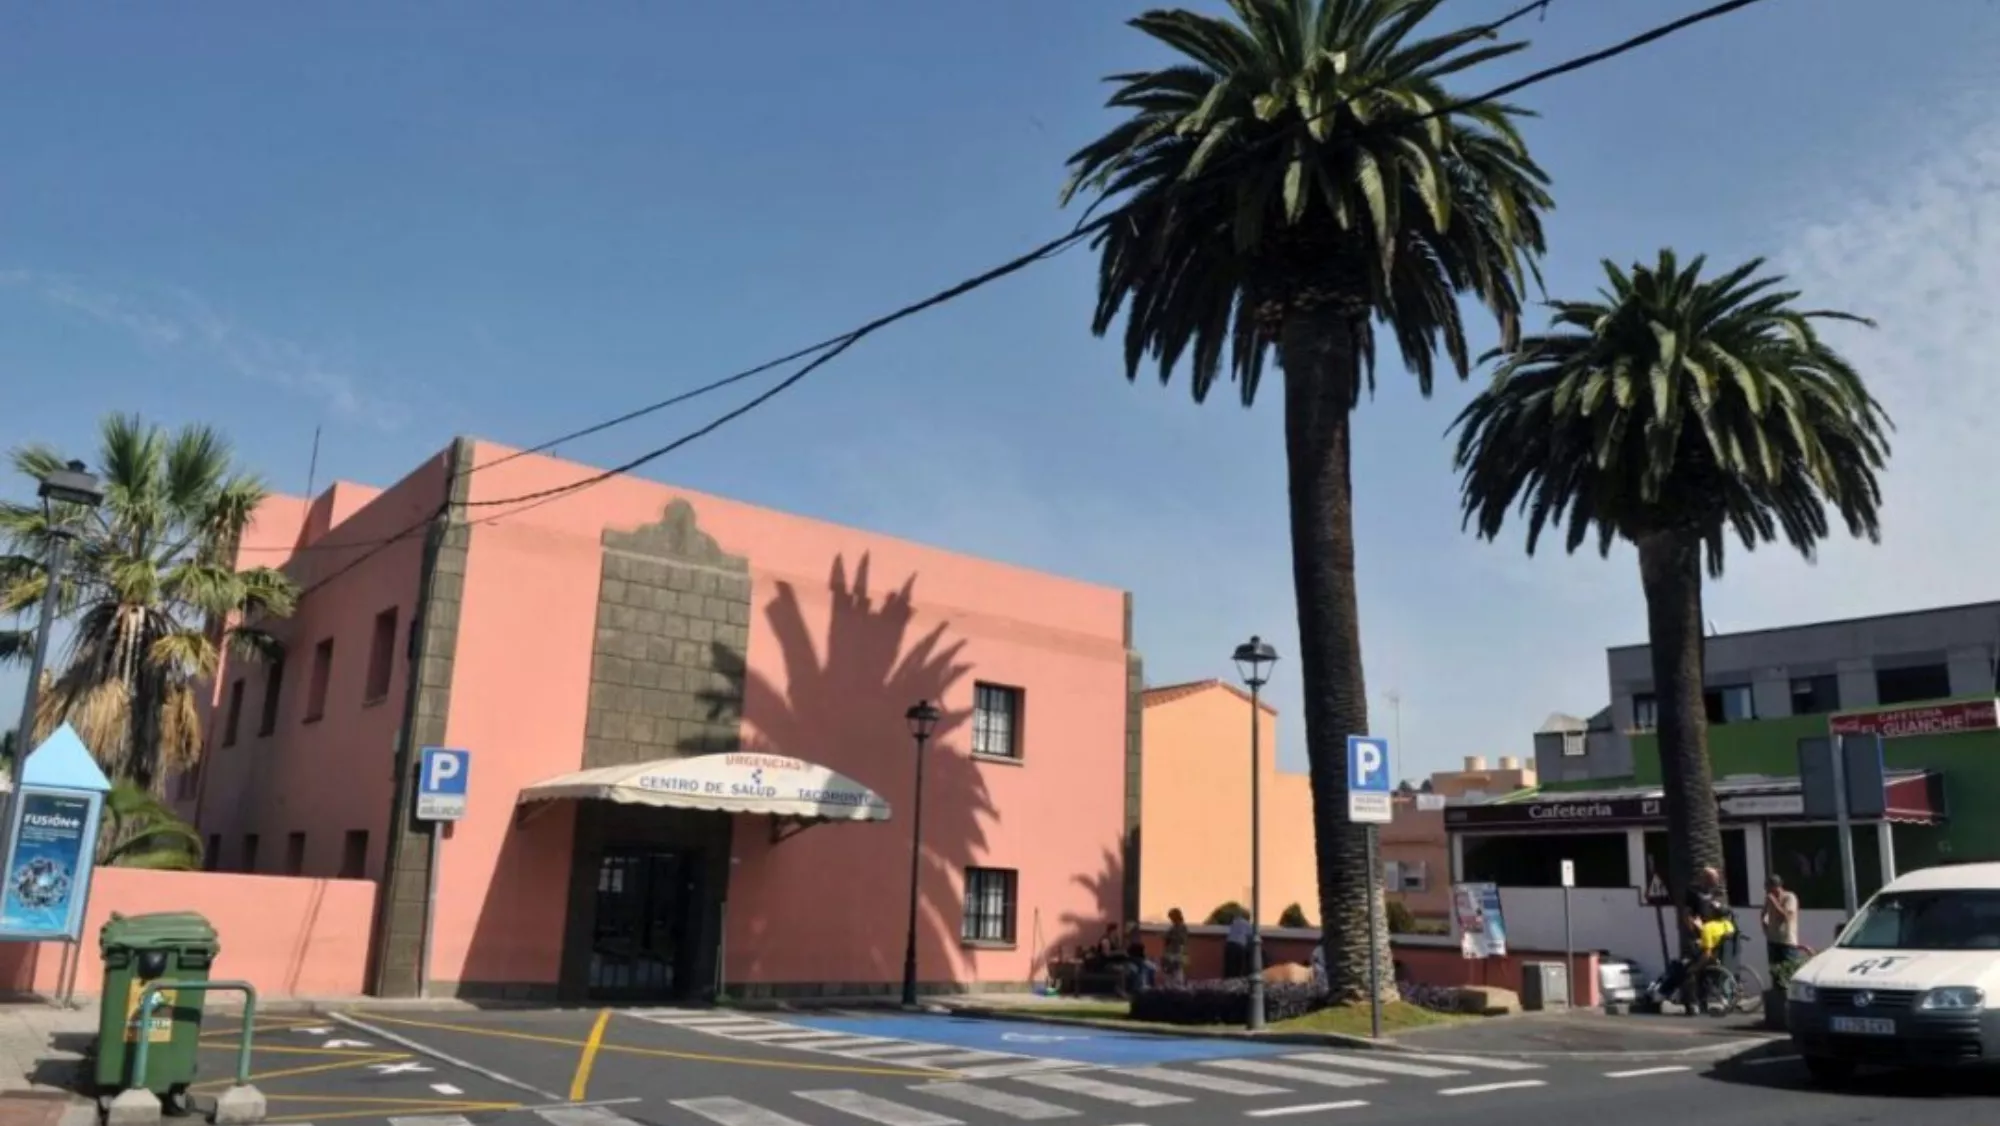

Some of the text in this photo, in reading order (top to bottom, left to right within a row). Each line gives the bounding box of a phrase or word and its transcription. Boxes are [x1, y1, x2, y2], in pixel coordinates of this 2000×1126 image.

[1884, 715, 1963, 735] GUANCHE
[430, 752, 460, 790] P
[725, 754, 800, 770] URGENCIAS
[1356, 742, 1381, 787] P
[640, 776, 699, 791] CENTRO
[704, 781, 724, 794] DE
[731, 783, 776, 797] SALUD
[1528, 804, 1612, 819] Cafeteria
